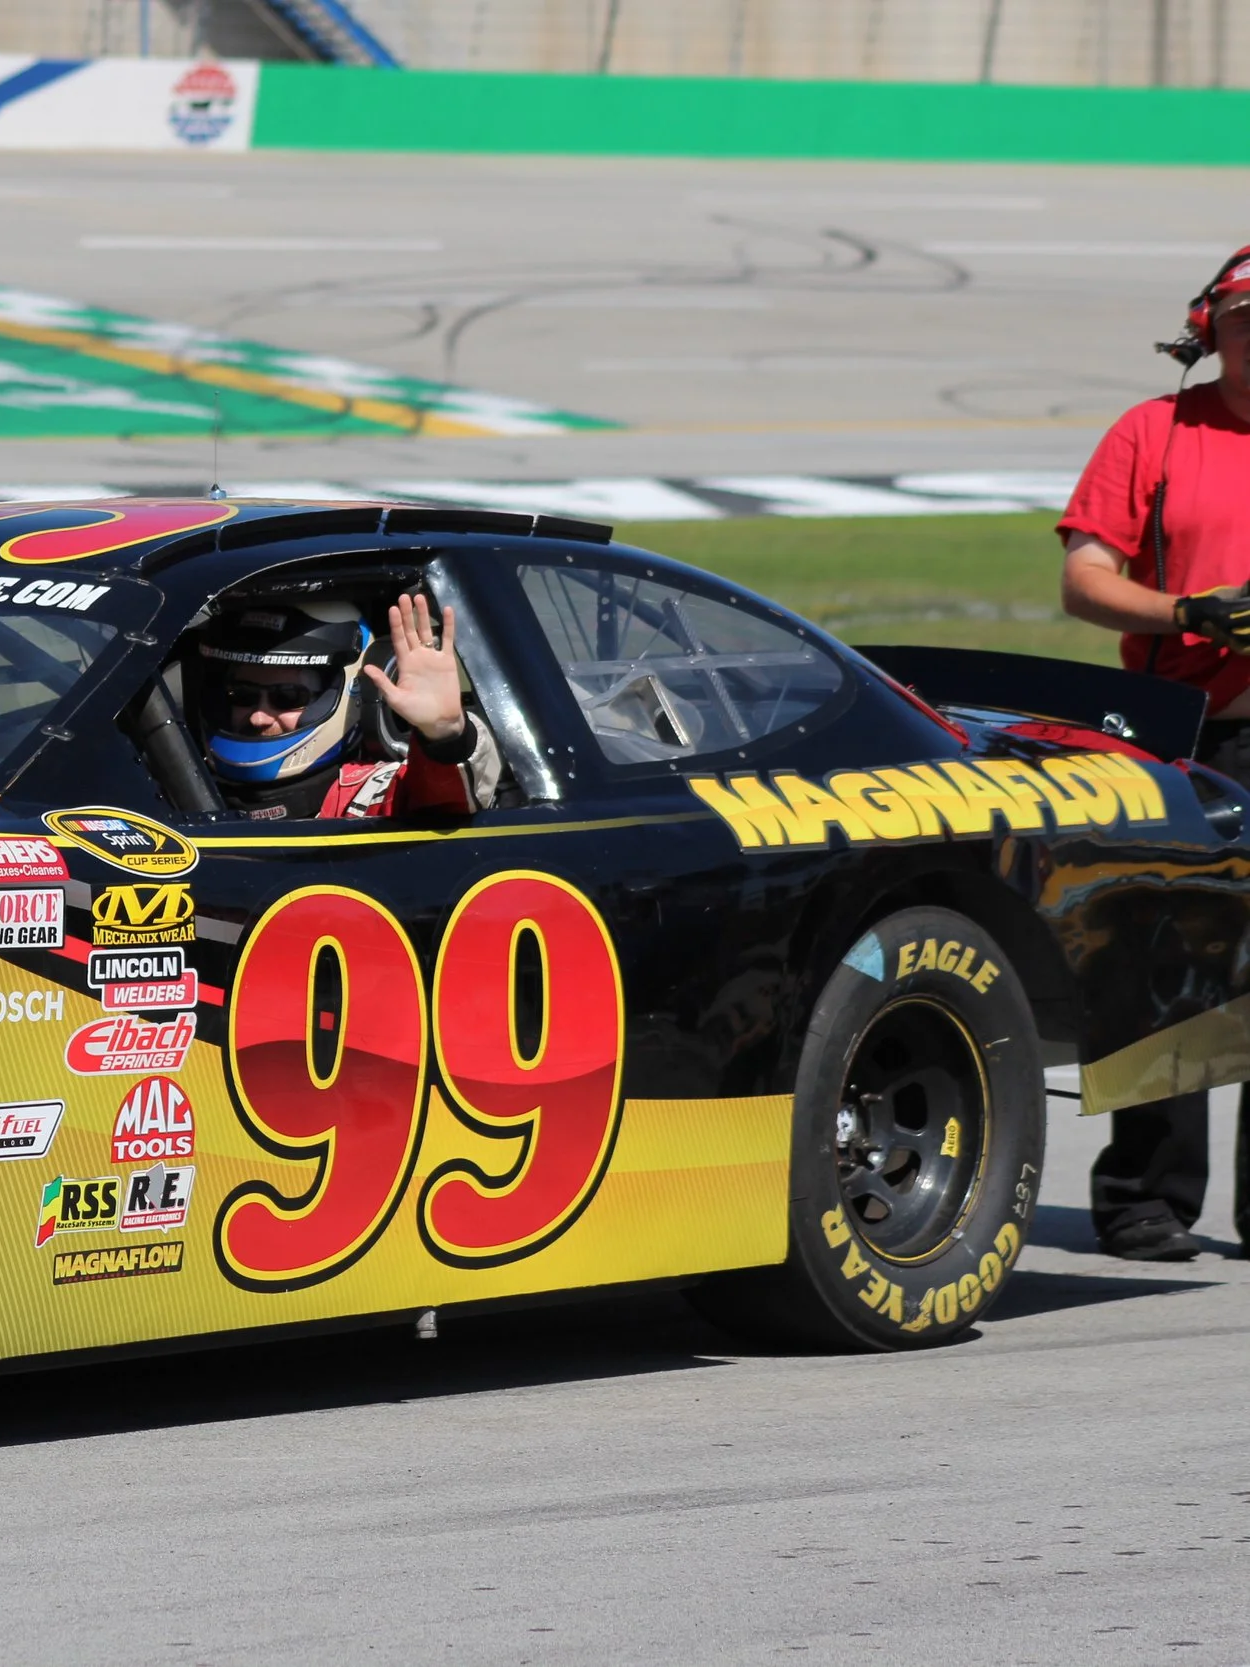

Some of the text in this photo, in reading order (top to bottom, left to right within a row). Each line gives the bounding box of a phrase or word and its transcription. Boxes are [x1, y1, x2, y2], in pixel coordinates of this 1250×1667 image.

[688, 752, 1167, 848] MAGNAFLOW
[81, 819, 128, 831] NASCAR
[102, 832, 150, 850] Sprint
[127, 856, 187, 866] CUP SERIES
[17, 927, 58, 945] GEAR
[92, 923, 196, 946] MECHANIX WEAR
[94, 956, 178, 980] LINCOLN
[896, 938, 1001, 994] EAGLE
[113, 984, 186, 1003] WELDERS
[67, 1016, 193, 1072] Eibach
[100, 1052, 176, 1070] SPRINGS
[216, 869, 626, 1288] 99
[115, 1079, 192, 1137] MAC
[113, 1136, 192, 1160] TOOLS
[60, 1181, 117, 1221] RSS
[56, 1219, 115, 1229] RaceSafe Systems
[123, 1215, 145, 1226] RACING
[54, 1243, 183, 1279] MAGNAFLOW
